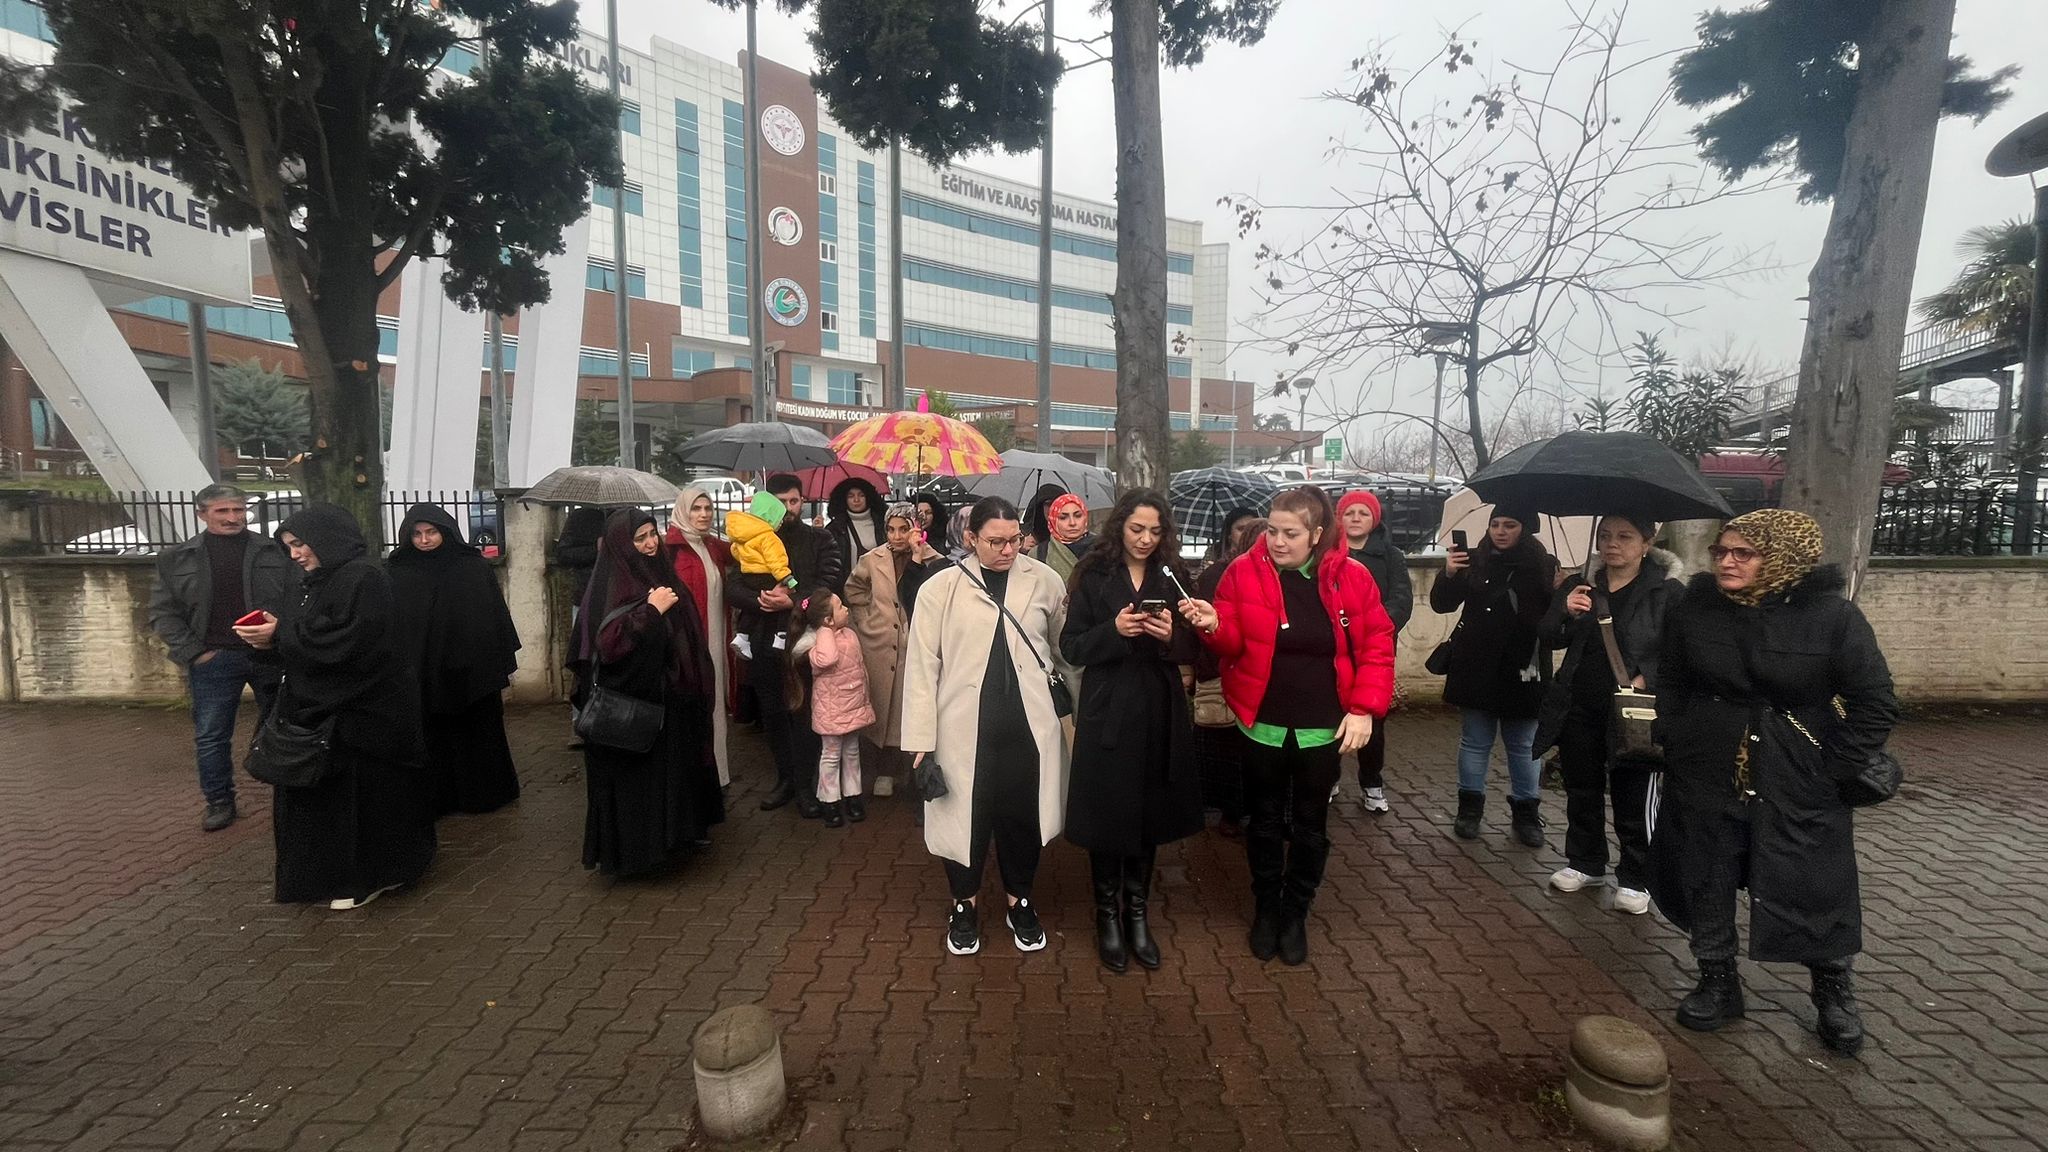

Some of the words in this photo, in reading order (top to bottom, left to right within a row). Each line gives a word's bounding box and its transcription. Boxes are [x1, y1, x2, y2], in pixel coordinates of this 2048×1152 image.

[941, 174, 985, 201] EĞİTİM
[986, 187, 1004, 205] VE
[1004, 193, 1074, 222] ARAŞTRMA
[798, 404, 816, 418] KADIN
[816, 406, 838, 421] DOĞUM
[838, 409, 847, 421] VE
